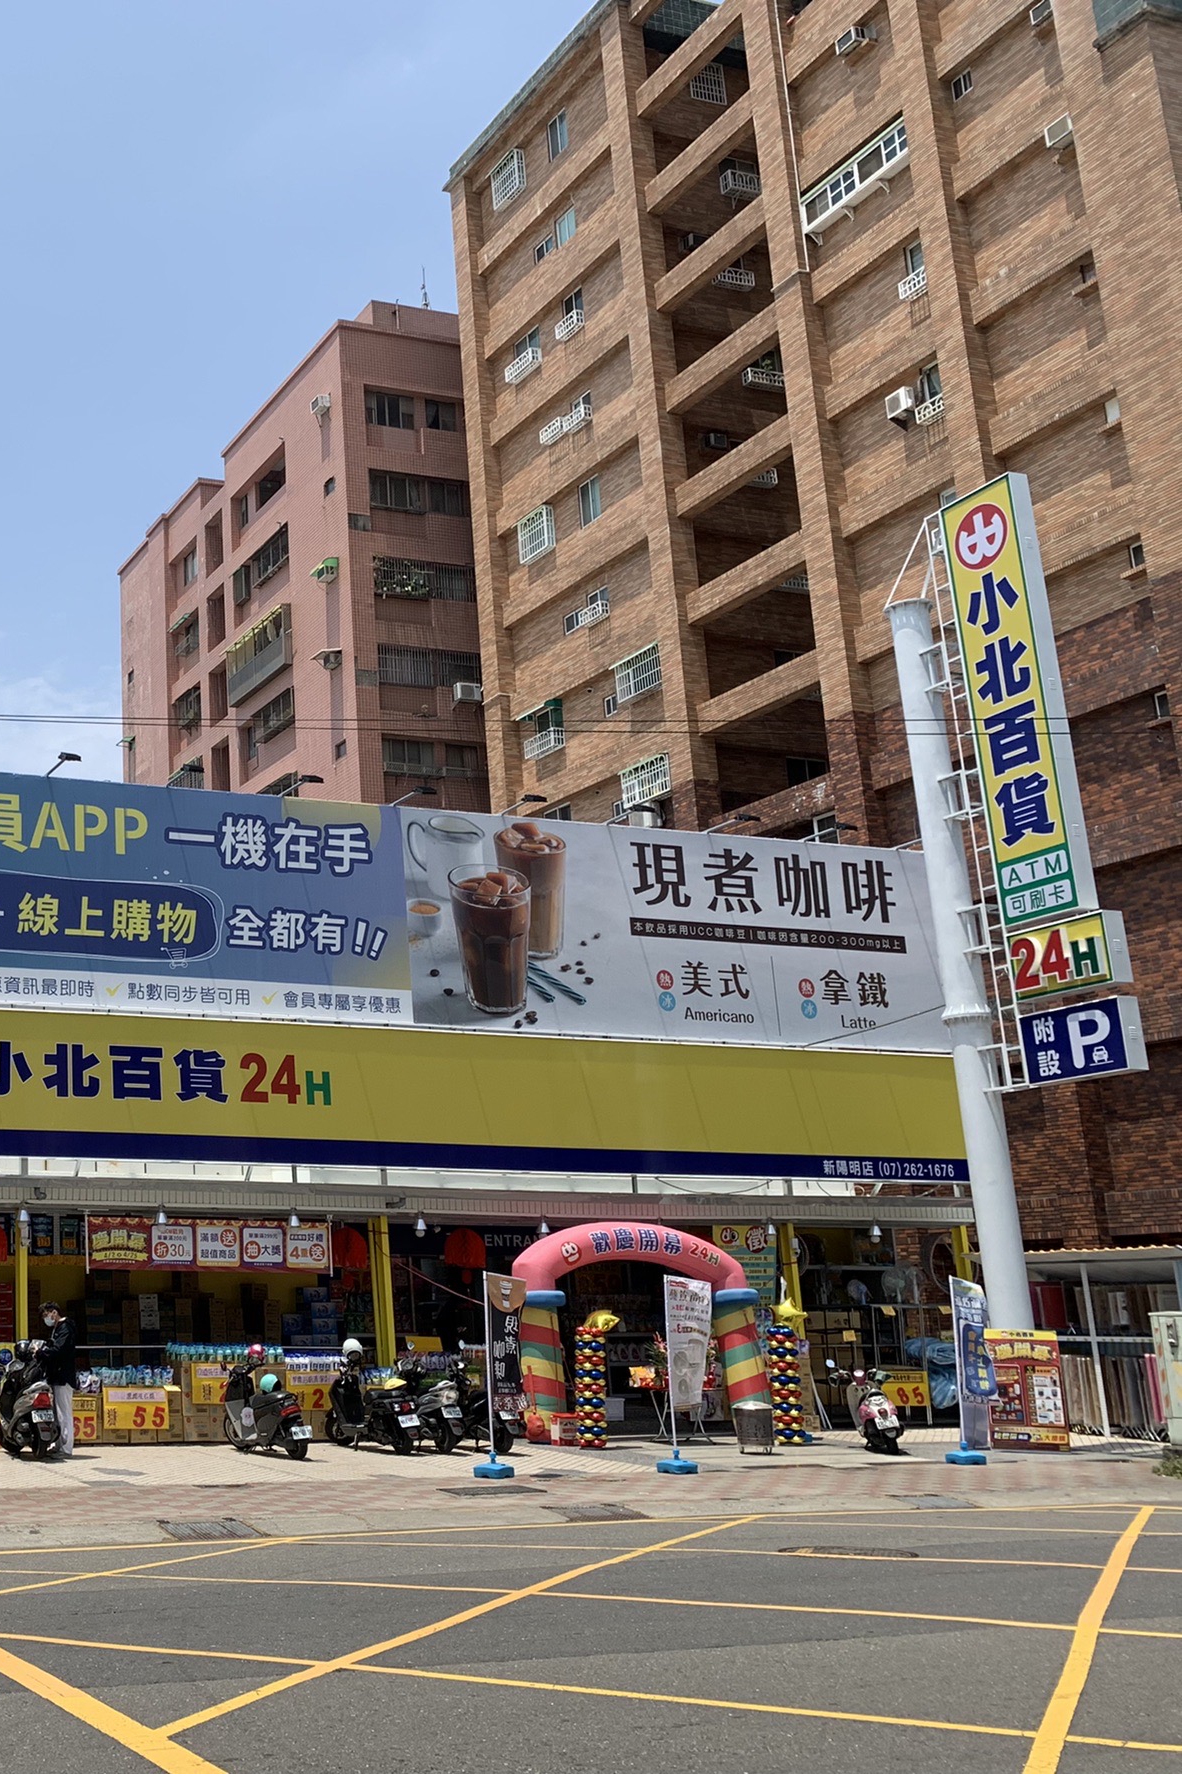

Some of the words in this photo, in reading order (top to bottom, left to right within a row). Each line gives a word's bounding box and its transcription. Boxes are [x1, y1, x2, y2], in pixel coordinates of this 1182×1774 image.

[966, 571, 1057, 849] 小北百貨
[167, 815, 373, 875] 一機在手
[629, 840, 897, 924] 現煮咖啡
[1007, 853, 1063, 887] ATM
[1010, 884, 1067, 914] 可刷卡
[1010, 927, 1102, 991] 24H
[127, 982, 251, 1005] 點數同步皆可用
[681, 960, 750, 1000] 美式
[819, 969, 890, 1009] 拿鐵
[282, 990, 402, 1014] 會員專屬享優惠
[684, 1007, 755, 1024] Americano
[841, 1015, 876, 1030] Latte
[1066, 1009, 1111, 1069] P
[1032, 1016, 1062, 1077] 附設
[823, 1159, 874, 1176] 新陽明店
[200, 1248, 237, 1260] 超值商品
[588, 1226, 684, 1257] 歡慶開幕
[689, 1241, 721, 1266] 24H
[896, 1385, 925, 1405] 85
[132, 1405, 166, 1429] 55
